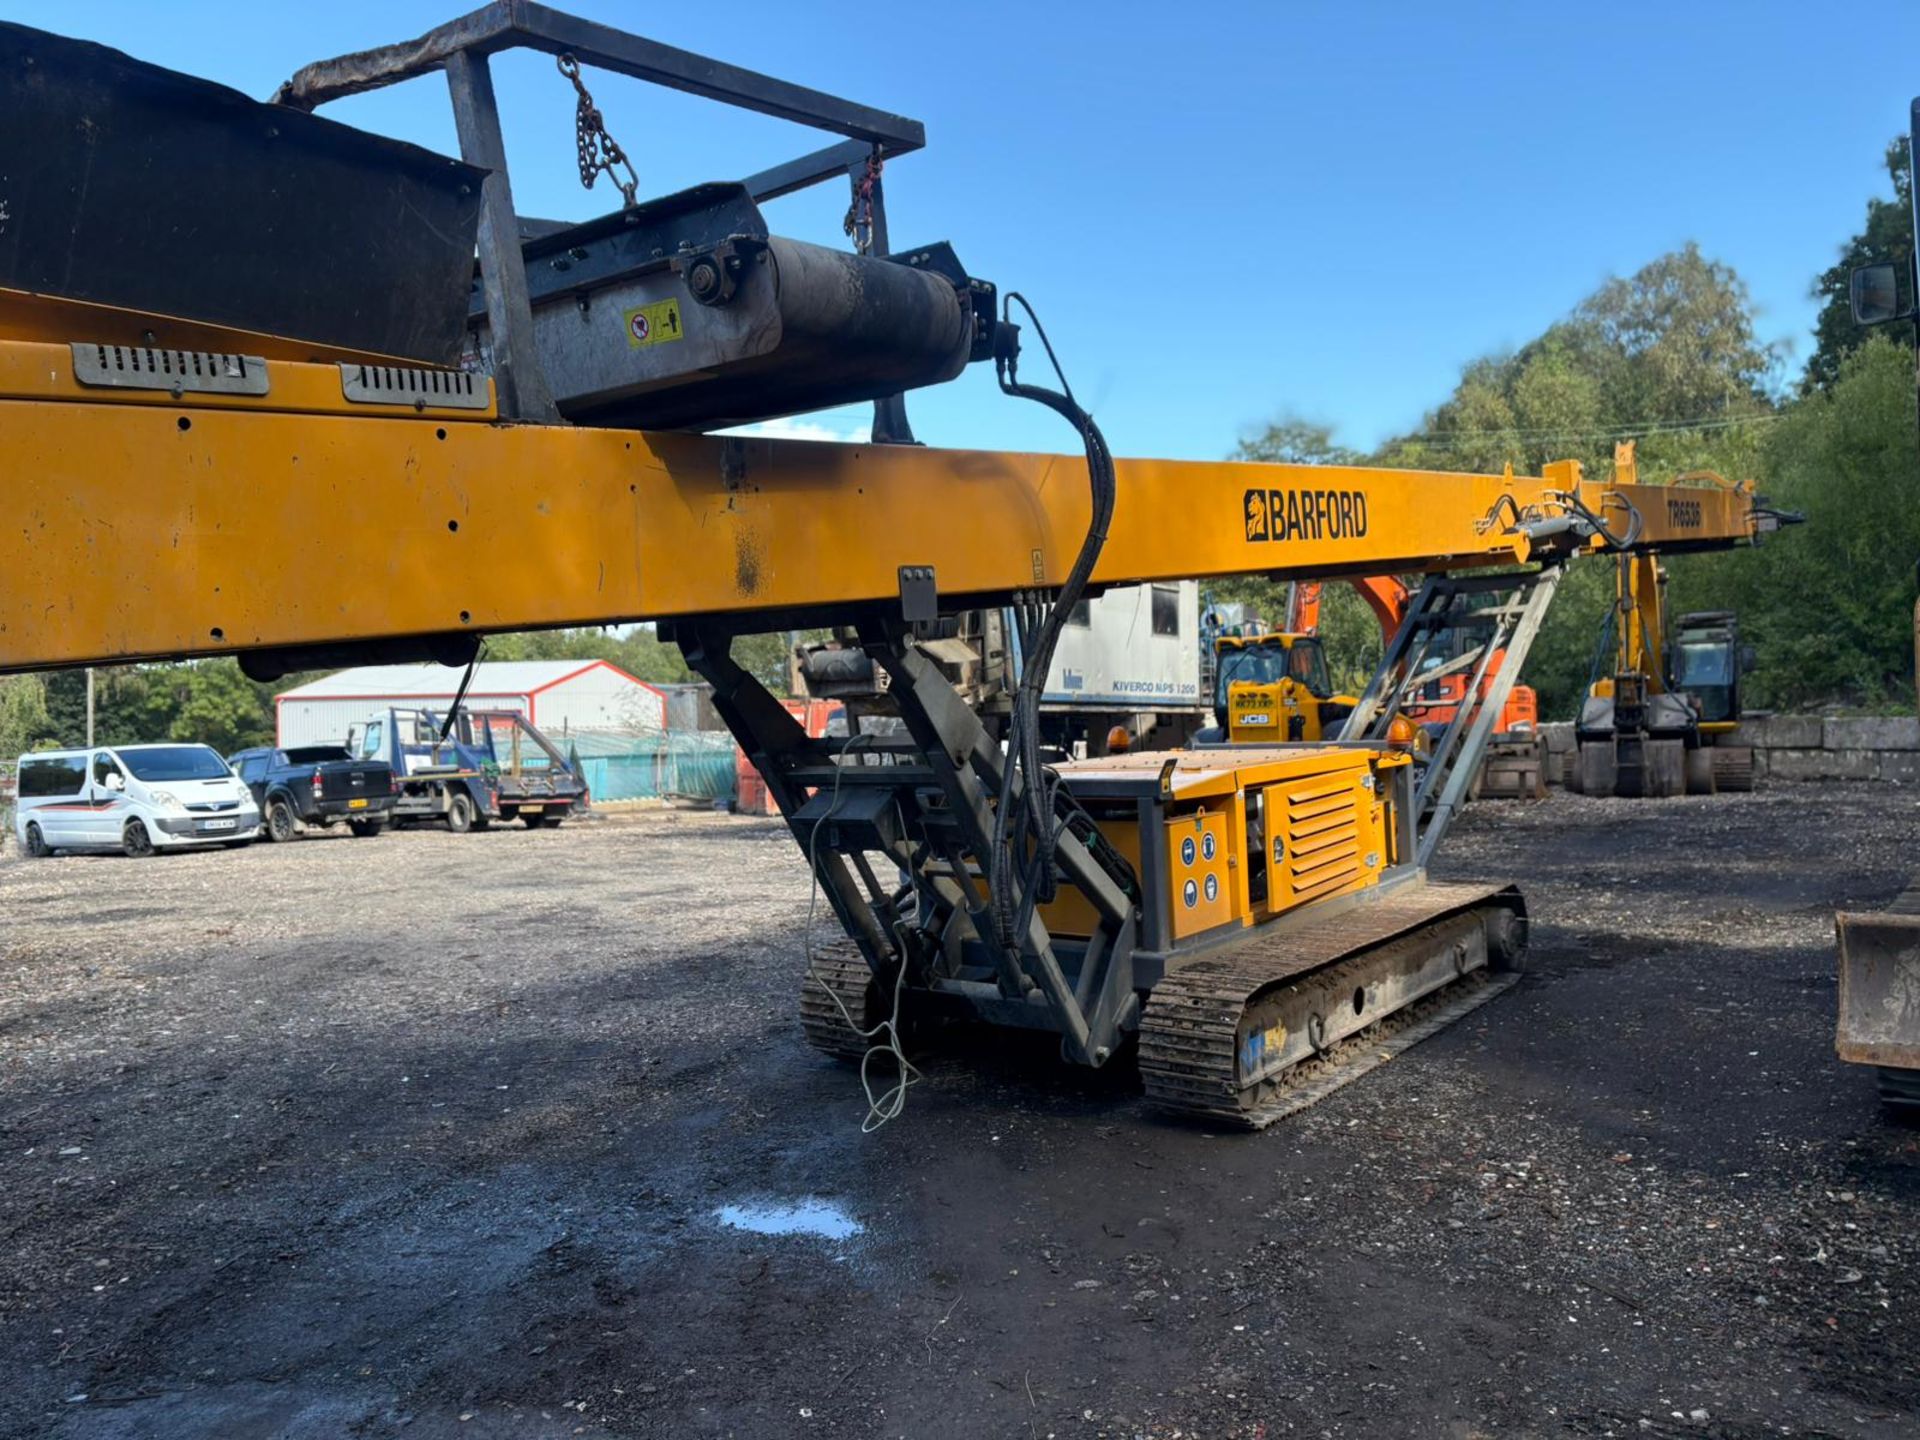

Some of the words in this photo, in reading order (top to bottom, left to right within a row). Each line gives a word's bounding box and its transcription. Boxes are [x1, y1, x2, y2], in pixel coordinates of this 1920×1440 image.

[1269, 490, 1367, 541] BARFORD
[1113, 681, 1153, 693] KIVERCO
[1176, 684, 1196, 694] 1200
[1240, 714, 1268, 724] JCB
